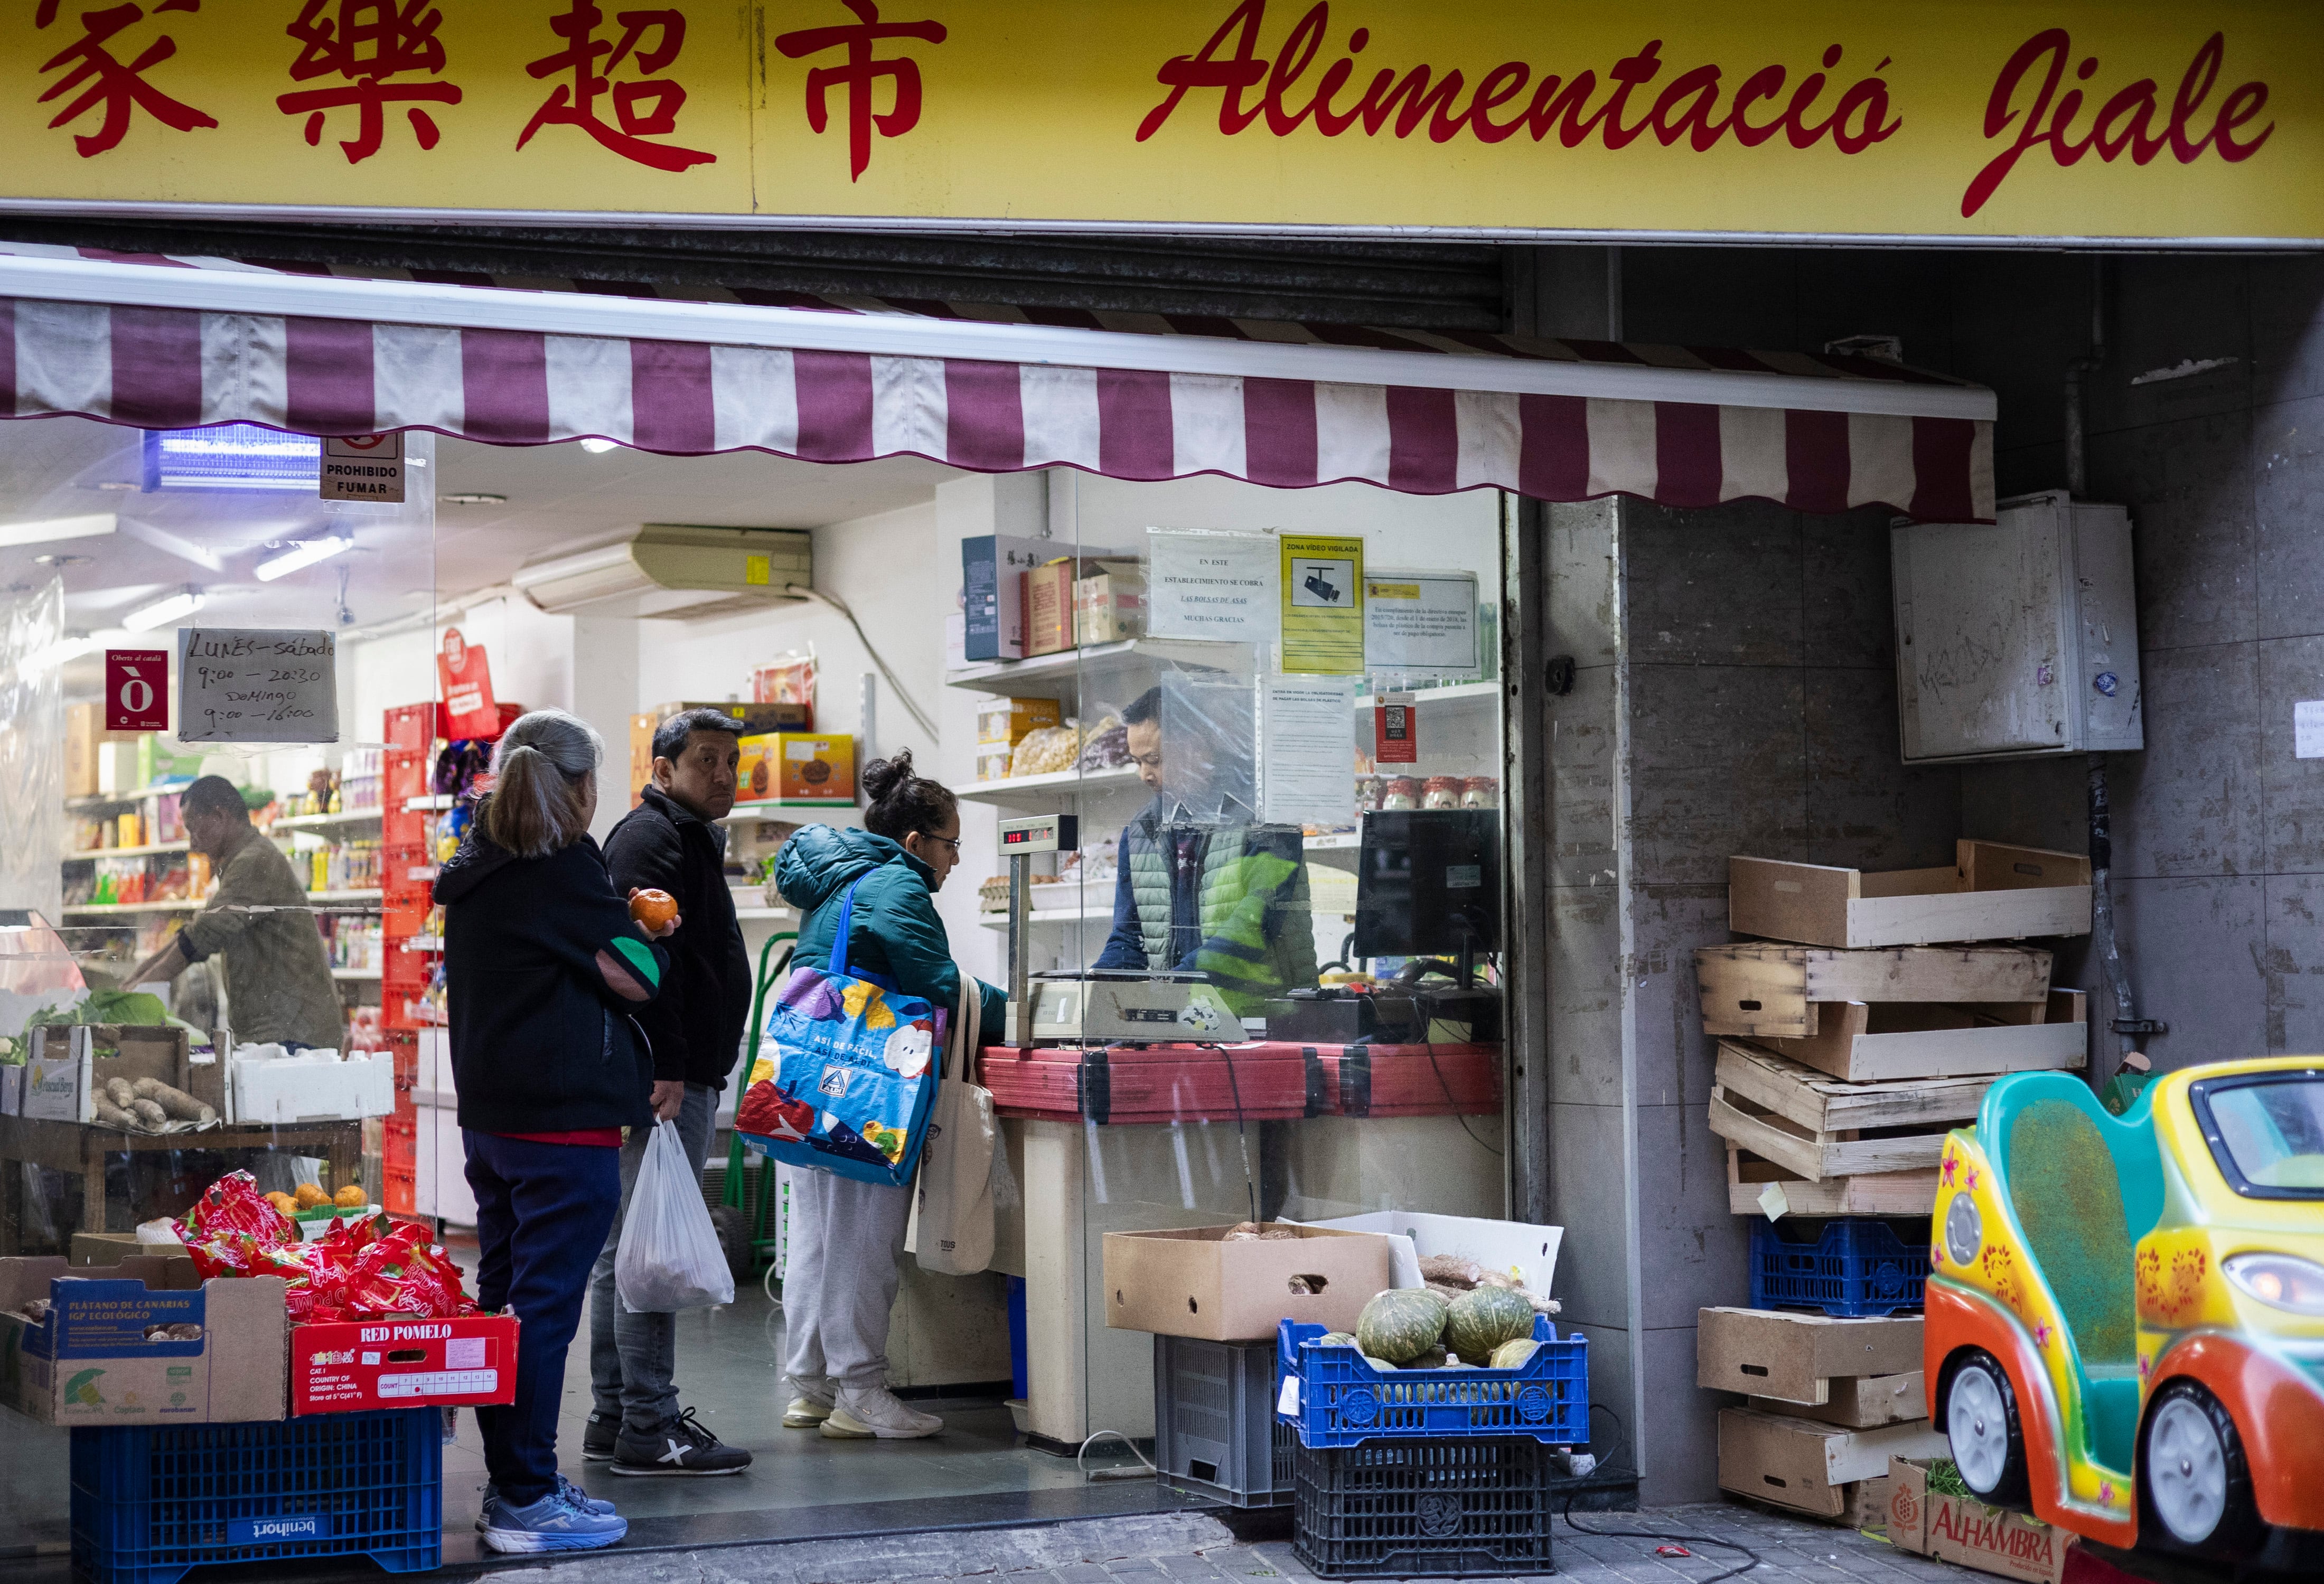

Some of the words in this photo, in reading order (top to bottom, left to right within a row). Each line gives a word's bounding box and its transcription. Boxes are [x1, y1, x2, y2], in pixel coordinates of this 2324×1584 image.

[1136, 0, 1902, 155] Alimentació
[1961, 27, 2275, 219] Jiale
[327, 464, 397, 477] PROHIBIDO
[338, 481, 387, 494] FUMAR
[1165, 577, 1229, 586] ESTABLECIMIENTO
[198, 667, 233, 689] 9:00
[268, 669, 320, 683] 20:30
[120, 666, 154, 713] Ò
[204, 708, 242, 728] 9:00
[814, 1035, 832, 1046] ASÍ
[832, 1041, 846, 1050] DE
[815, 1046, 833, 1057] ASÍ
[834, 1052, 846, 1061] DE
[848, 1055, 872, 1067] ALDI
[941, 1240, 956, 1249] TOUS
[69, 1301, 118, 1310] PLÁTANO
[120, 1301, 133, 1309] DE
[136, 1299, 190, 1308] CANARIAS
[89, 1310, 151, 1320] ECOLÓGICO
[361, 1326, 390, 1343] RED
[393, 1324, 452, 1341] POMELO
[310, 1375, 340, 1384] COUNTRY
[253, 1520, 315, 1538] benihort
[1932, 1502, 2054, 1566] ALHAMBRA
